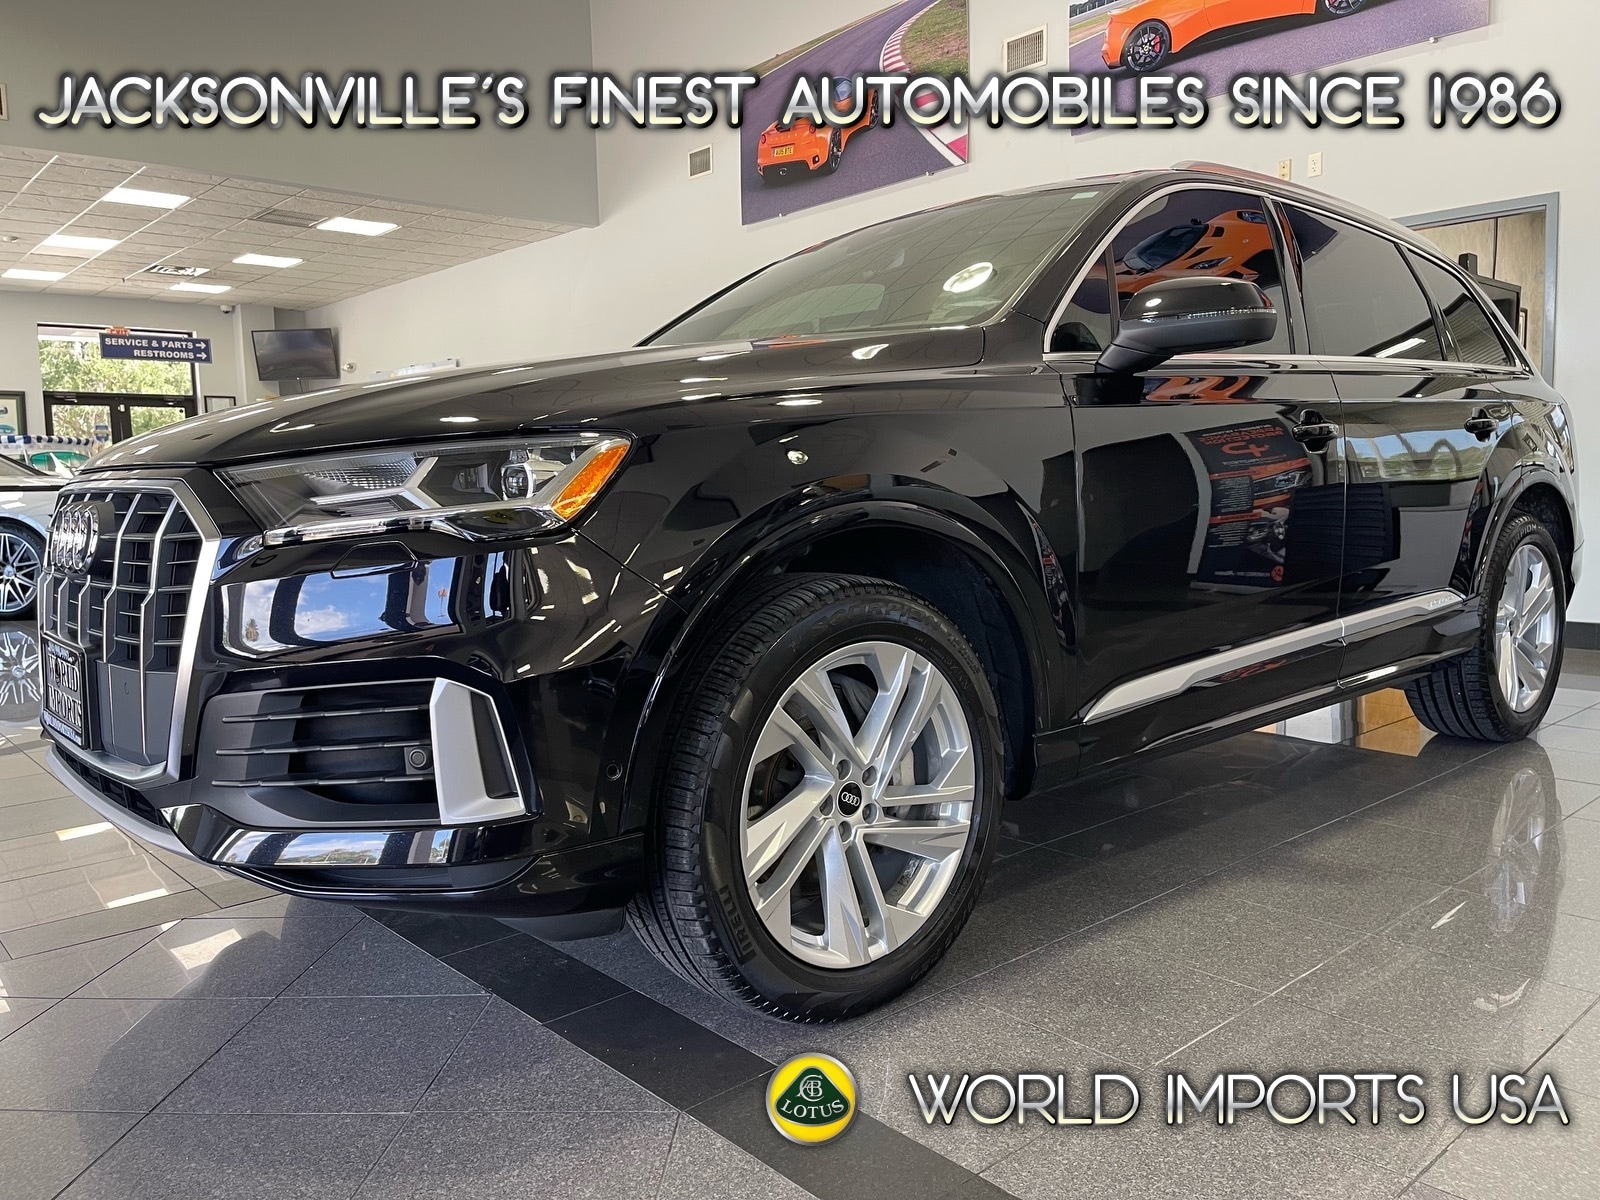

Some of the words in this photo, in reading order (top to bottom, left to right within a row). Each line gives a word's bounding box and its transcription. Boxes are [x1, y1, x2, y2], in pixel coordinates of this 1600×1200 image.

[105, 338, 149, 347] SERVICE
[161, 341, 194, 349] PARTS
[133, 349, 195, 359] RESTROOMS
